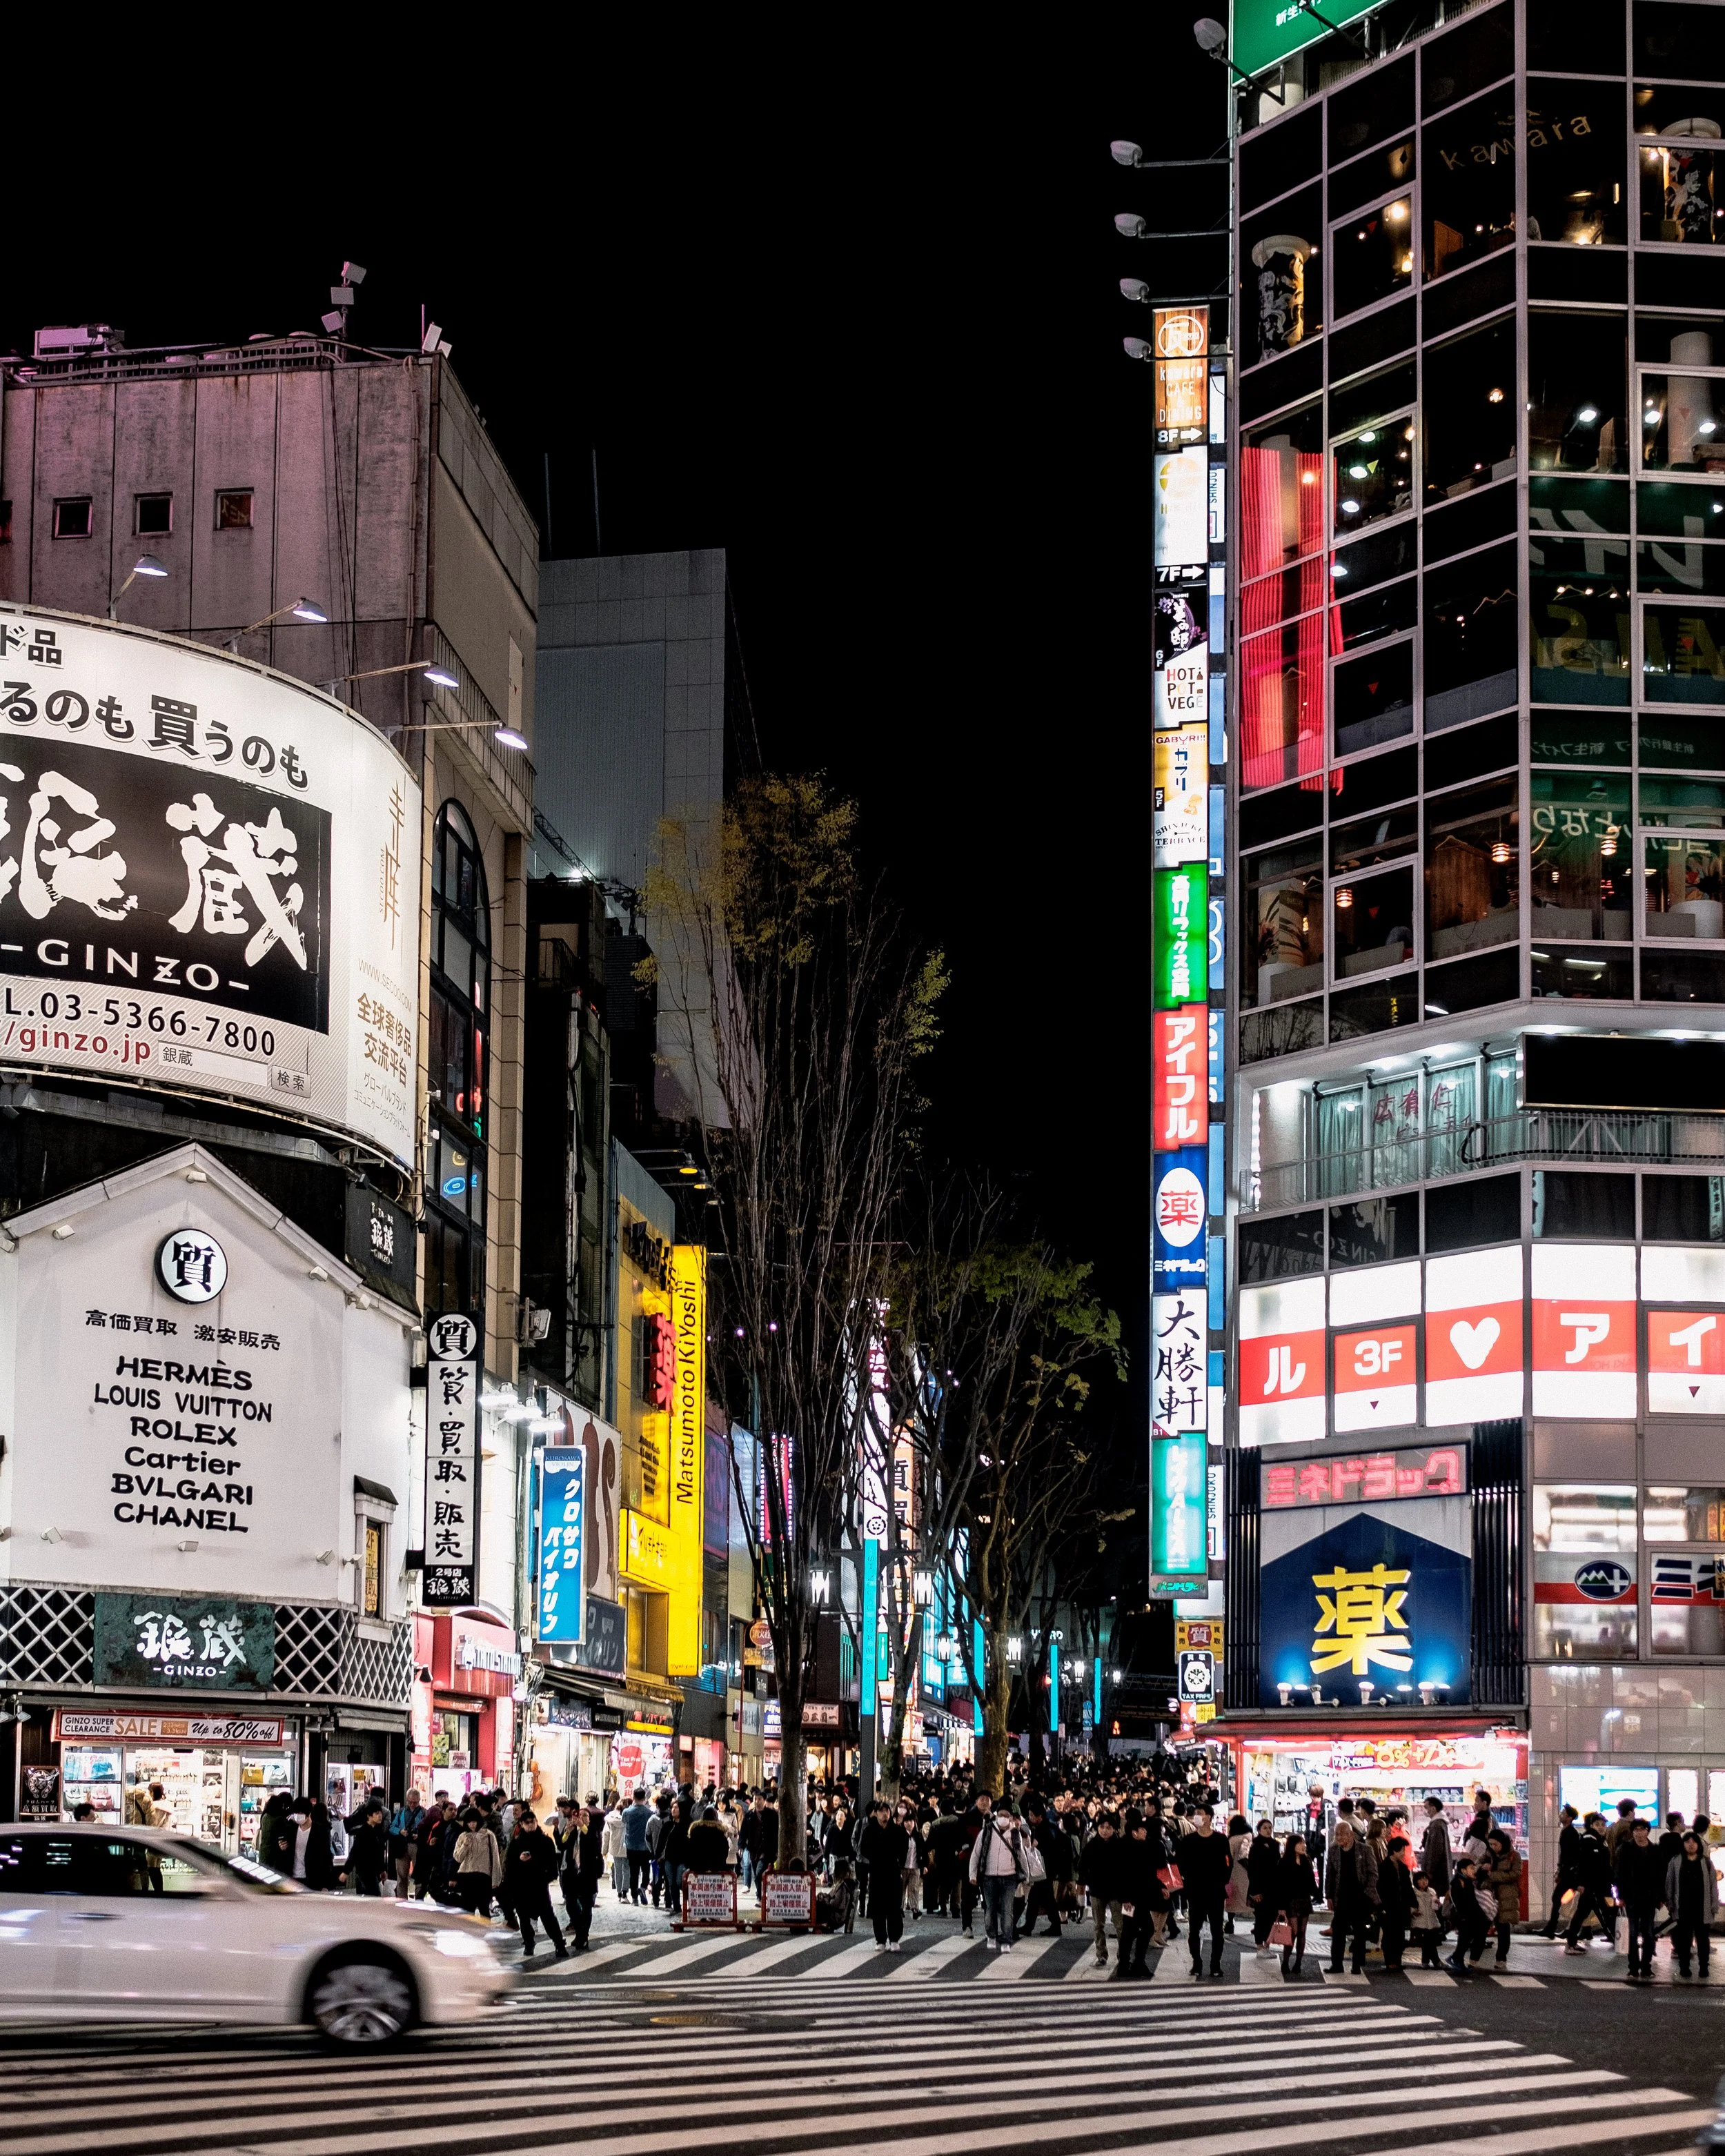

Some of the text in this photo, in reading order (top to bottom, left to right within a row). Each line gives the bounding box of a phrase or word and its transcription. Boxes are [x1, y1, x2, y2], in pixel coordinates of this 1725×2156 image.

[1166, 381, 1196, 397] CAFE
[1159, 405, 1203, 423] DINING
[1157, 429, 1179, 444] 8F
[1156, 566, 1182, 582] 7F
[1167, 667, 1196, 682] HOT
[1167, 682, 1196, 696] POT
[1167, 695, 1203, 710] VEGE
[1174, 748, 1188, 791] ガブリ
[1155, 790, 1164, 808] 5F
[357, 991, 412, 1059] 全球奢侈品
[162, 1047, 305, 1091] 銀蔵 検索
[364, 1031, 408, 1089] 交流平台
[1165, 1017, 1199, 1140] アイフル
[1159, 1190, 1199, 1227] 薬
[172, 1240, 216, 1294] 質
[86, 1309, 281, 1351] 高価買取 激安販売
[436, 1318, 471, 1356] 質
[116, 1354, 253, 1392] HERMÈS
[1154, 1299, 1205, 1426] 大勝軒
[1263, 1346, 1306, 1396] ル
[1354, 1340, 1402, 1376] 3F
[94, 1383, 273, 1423] LOUIS VUITTON
[130, 1416, 238, 1447] ROLEX
[124, 1446, 241, 1476] Cartier
[1266, 1449, 1461, 1505] ミネドラッグ
[110, 1472, 253, 1506] BVLGARI
[113, 1502, 249, 1534] CHANEL
[563, 1478, 581, 1570] クロサワ
[426, 1576, 471, 1597] 銀蔵
[435, 1567, 462, 1577] 2号店
[542, 1526, 564, 1634] バイオリン
[1190, 1626, 1210, 1643] 質
[1309, 1562, 1414, 1676] 薬
[132, 1610, 247, 1665] 銀蔵
[64, 1725, 110, 1733] CLEARANCE
[115, 1717, 157, 1736] SALE
[191, 1722, 210, 1734] Up
[221, 1721, 259, 1739] 80%
[259, 1726, 275, 1739] off
[22, 1804, 57, 1813] 高額買取
[691, 1899, 729, 1908] 路上喫煙禁止
